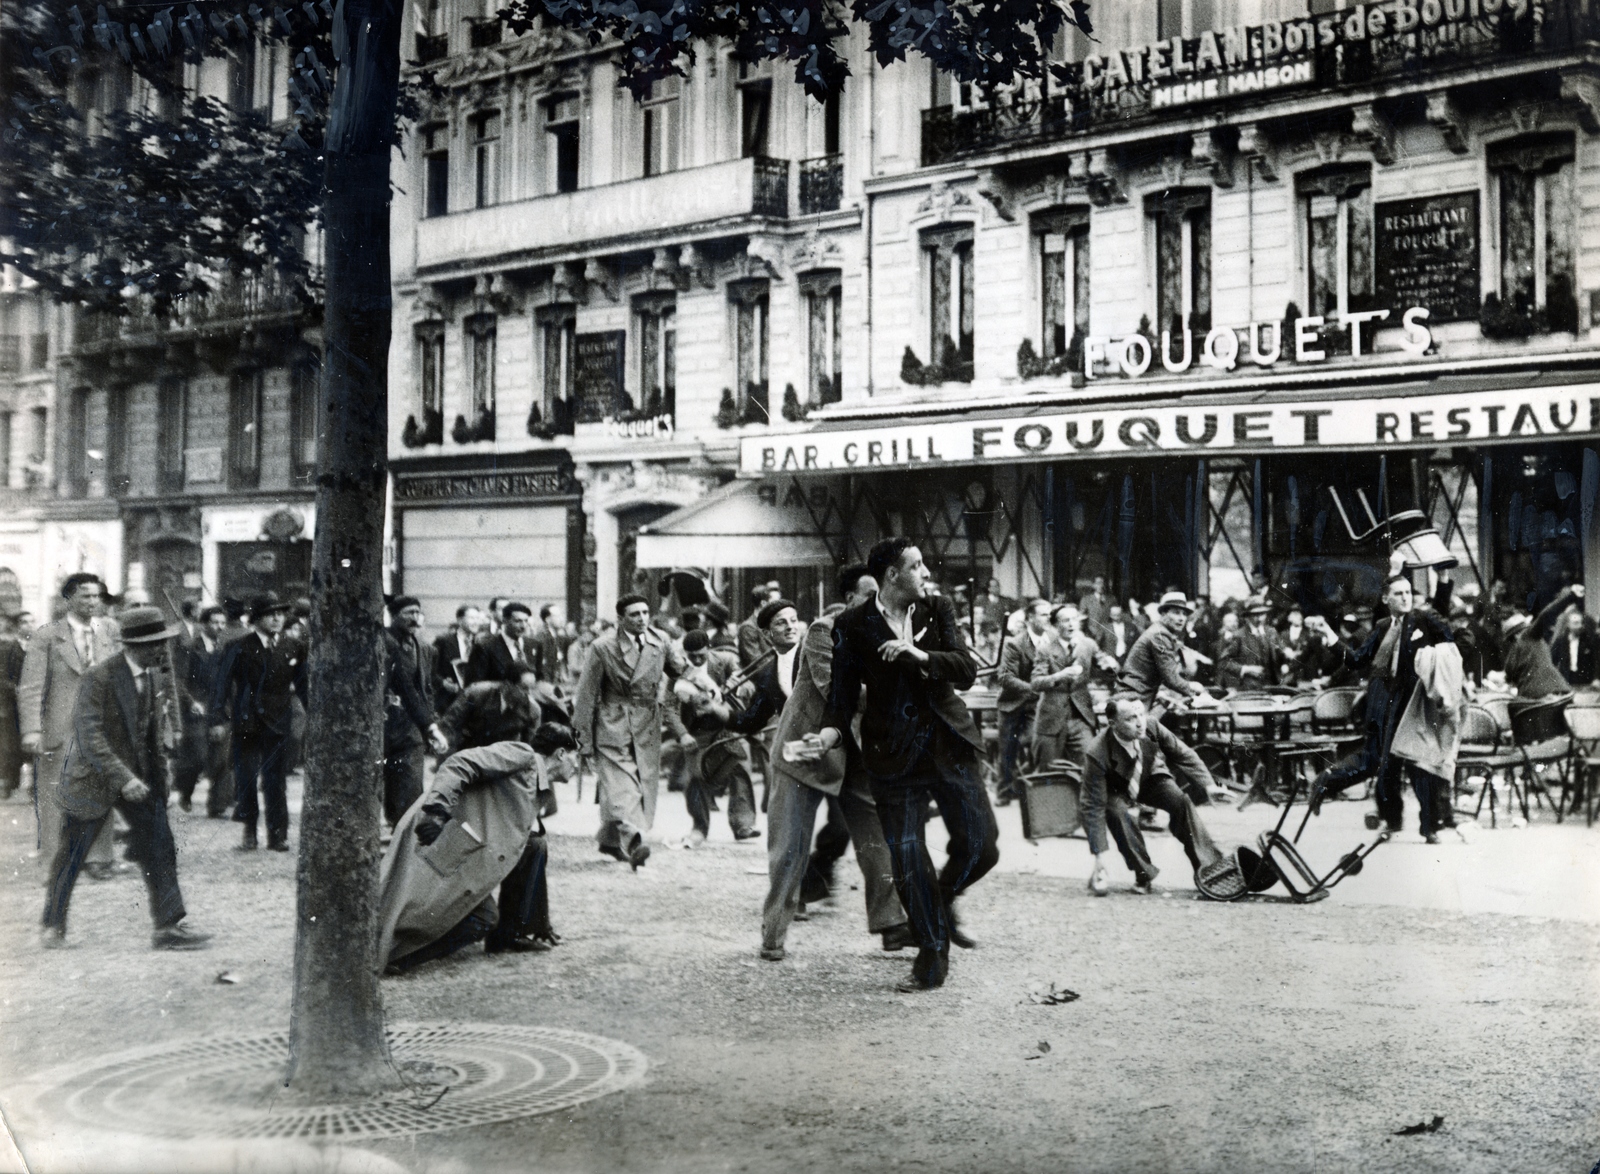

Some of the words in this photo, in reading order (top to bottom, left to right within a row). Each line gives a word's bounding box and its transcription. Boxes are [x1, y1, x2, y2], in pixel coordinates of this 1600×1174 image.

[1081, 25, 1249, 92] CATELAN
[1263, 18, 1338, 57] Bois
[1344, 5, 1386, 41] de
[1227, 61, 1312, 94] MAISON
[844, 436, 943, 464] GRILL
[972, 408, 1332, 456] FOUQUET
